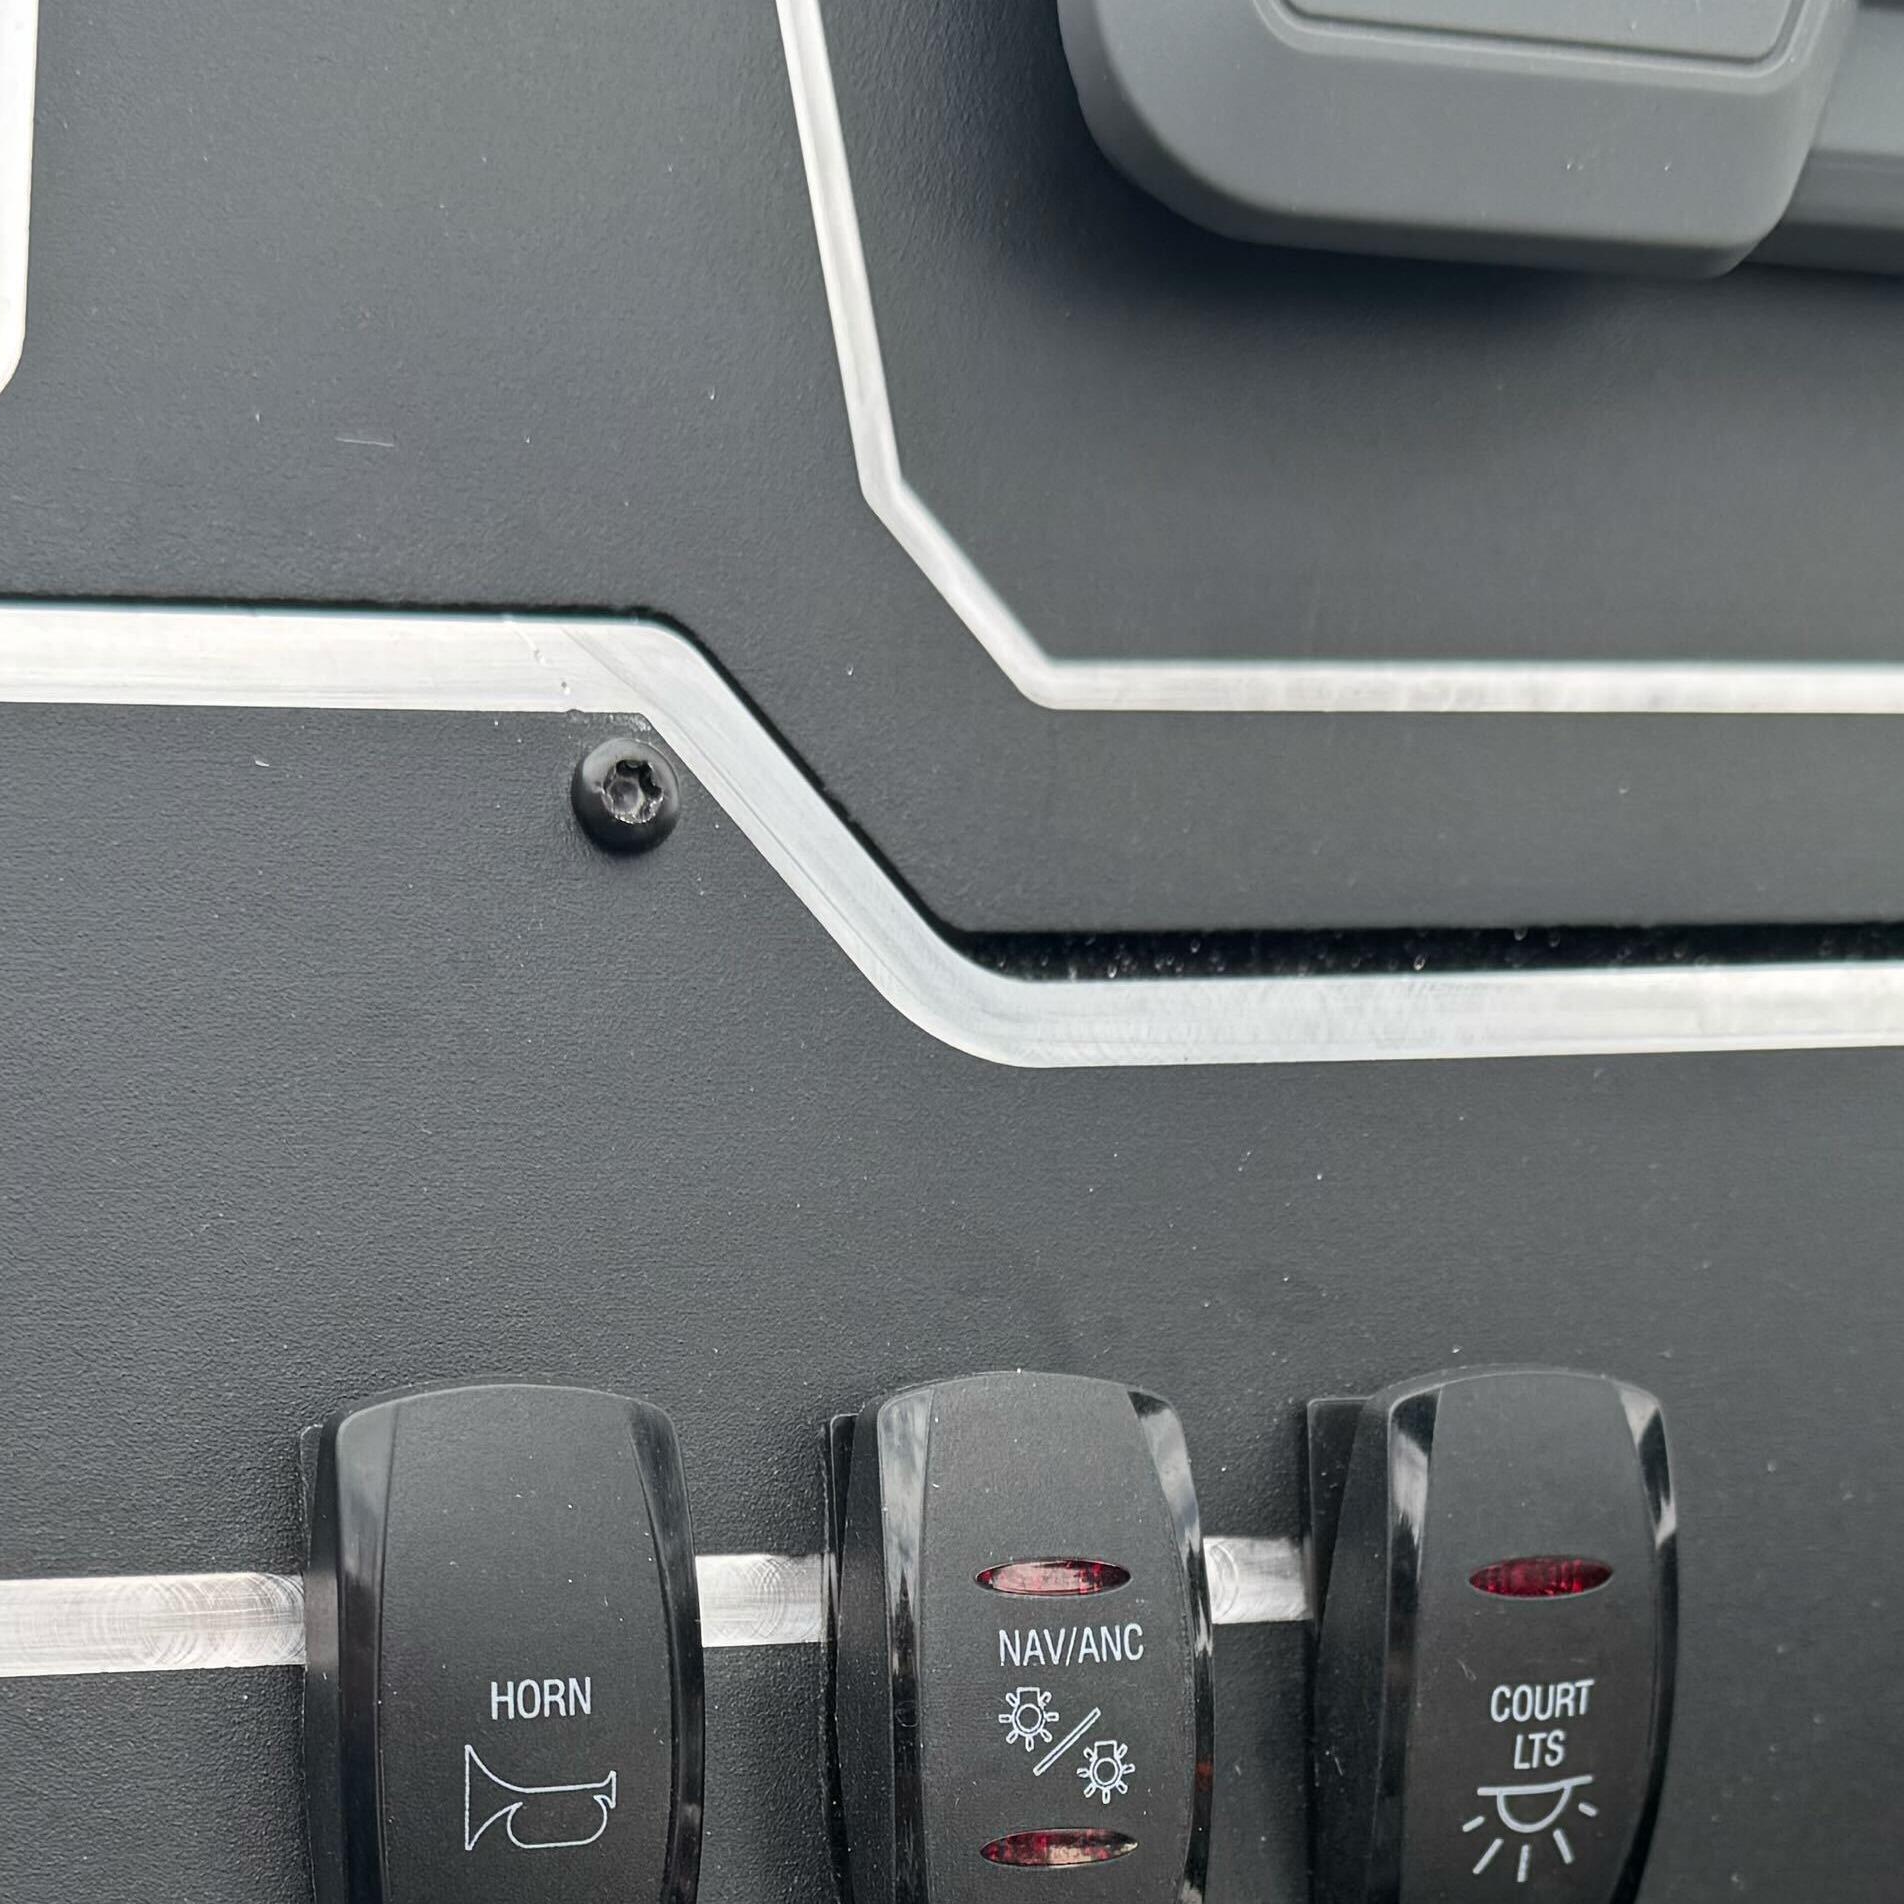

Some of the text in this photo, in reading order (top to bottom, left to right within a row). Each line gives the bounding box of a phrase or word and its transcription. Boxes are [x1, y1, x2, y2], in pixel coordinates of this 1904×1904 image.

[998, 1622, 1145, 1667] NAV/ANC
[489, 1676, 593, 1721] HORN
[1490, 1678, 1595, 1723] COURT
[1513, 1729, 1566, 1770] LTS
